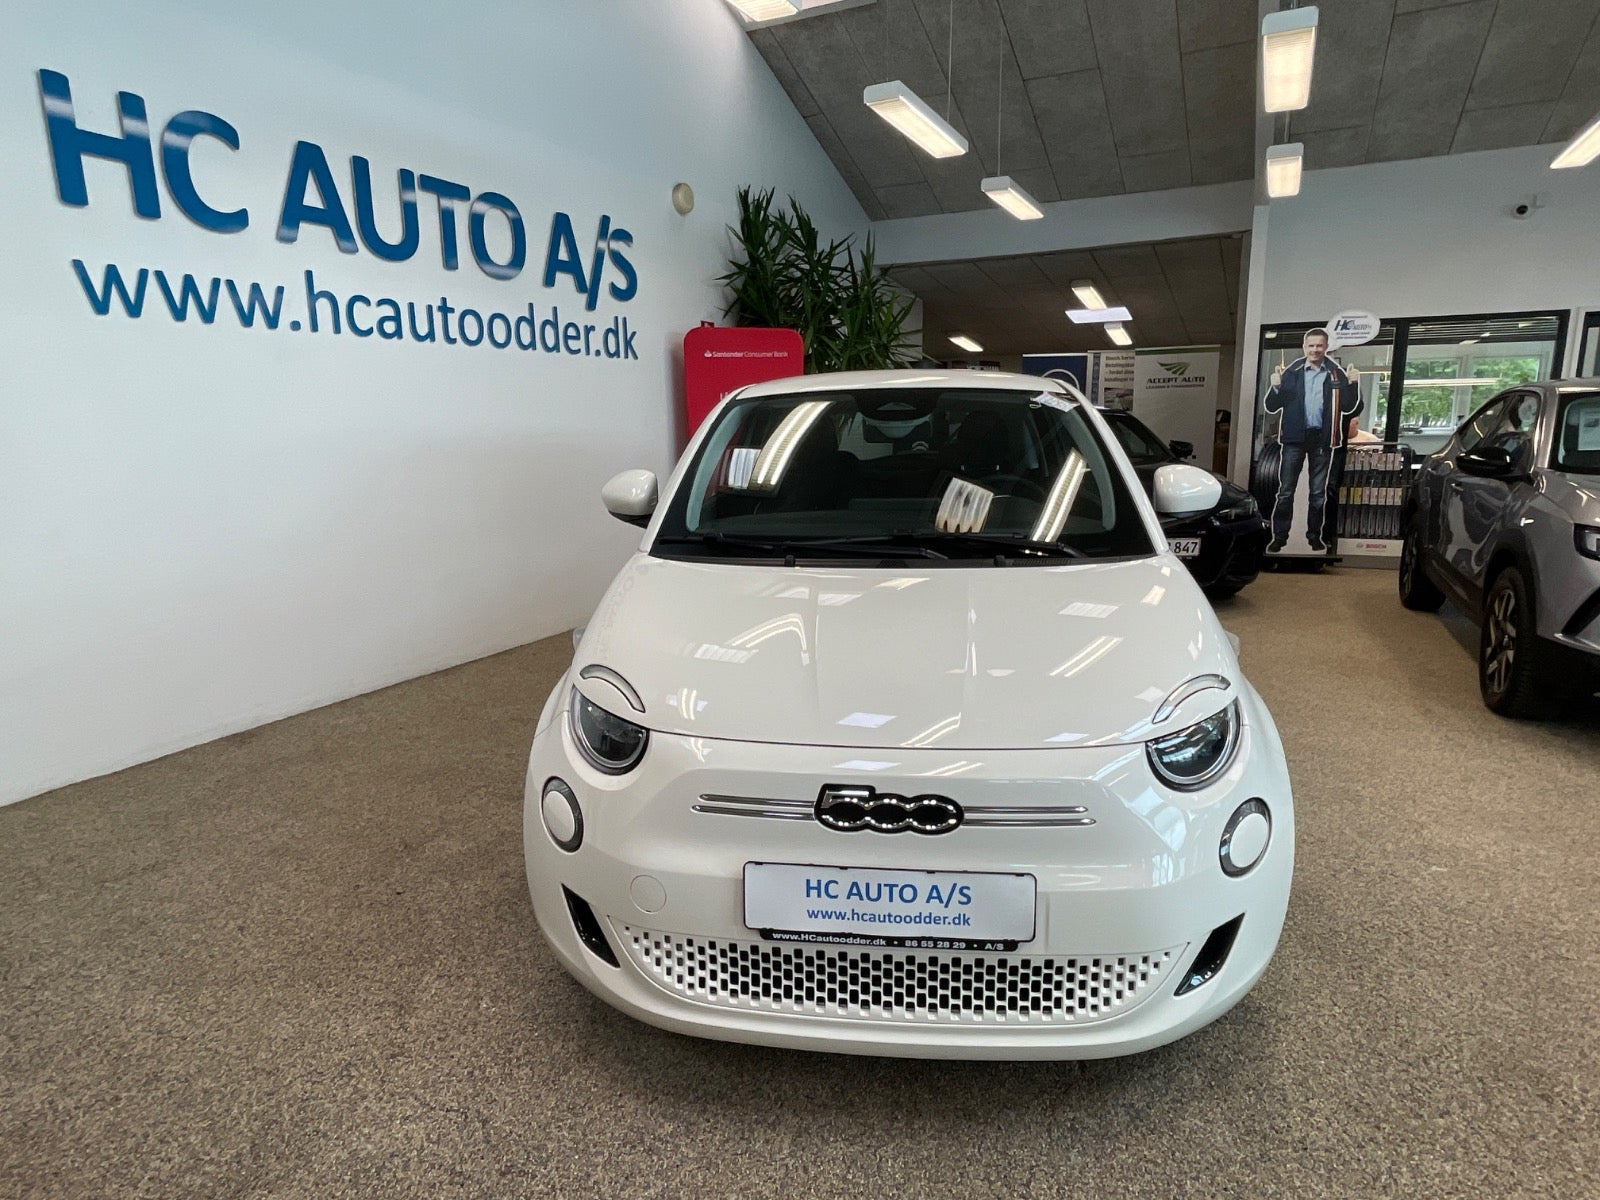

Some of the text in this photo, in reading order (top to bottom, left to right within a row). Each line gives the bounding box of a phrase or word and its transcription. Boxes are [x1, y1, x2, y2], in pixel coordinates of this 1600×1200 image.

[38, 68, 639, 312] HC AUTO A/S
[72, 258, 639, 361] www.hcautoodder.dk
[1173, 541, 1198, 554] 847
[816, 785, 961, 833] 500
[805, 878, 972, 909] HC AUTO A/S
[806, 908, 971, 927] www.hcautoodder.dk
[772, 931, 1005, 951] www.HCautoodder.dk 86 55 28 29 A/S
